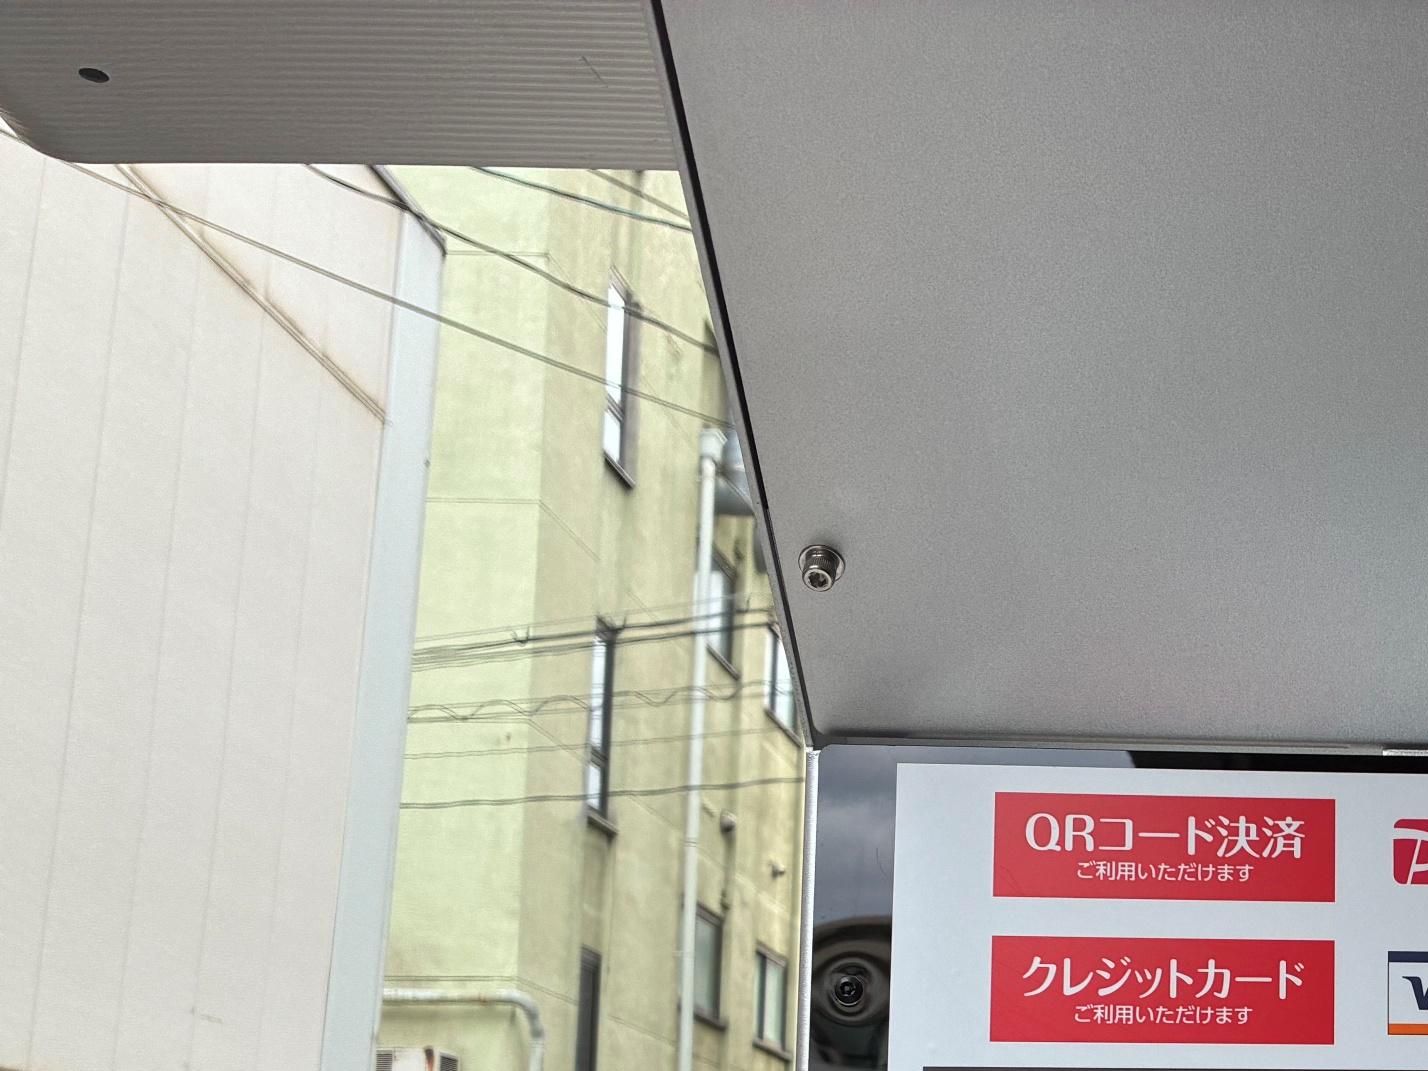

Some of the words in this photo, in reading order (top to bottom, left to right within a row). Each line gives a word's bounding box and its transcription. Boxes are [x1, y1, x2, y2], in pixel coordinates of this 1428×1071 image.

[1026, 813, 1304, 858] QRコード決済
[1078, 861, 1253, 882] ご利用いただけます
[1023, 957, 1304, 999] クレジットカード
[1075, 1004, 1253, 1025] ご利用いただけます
